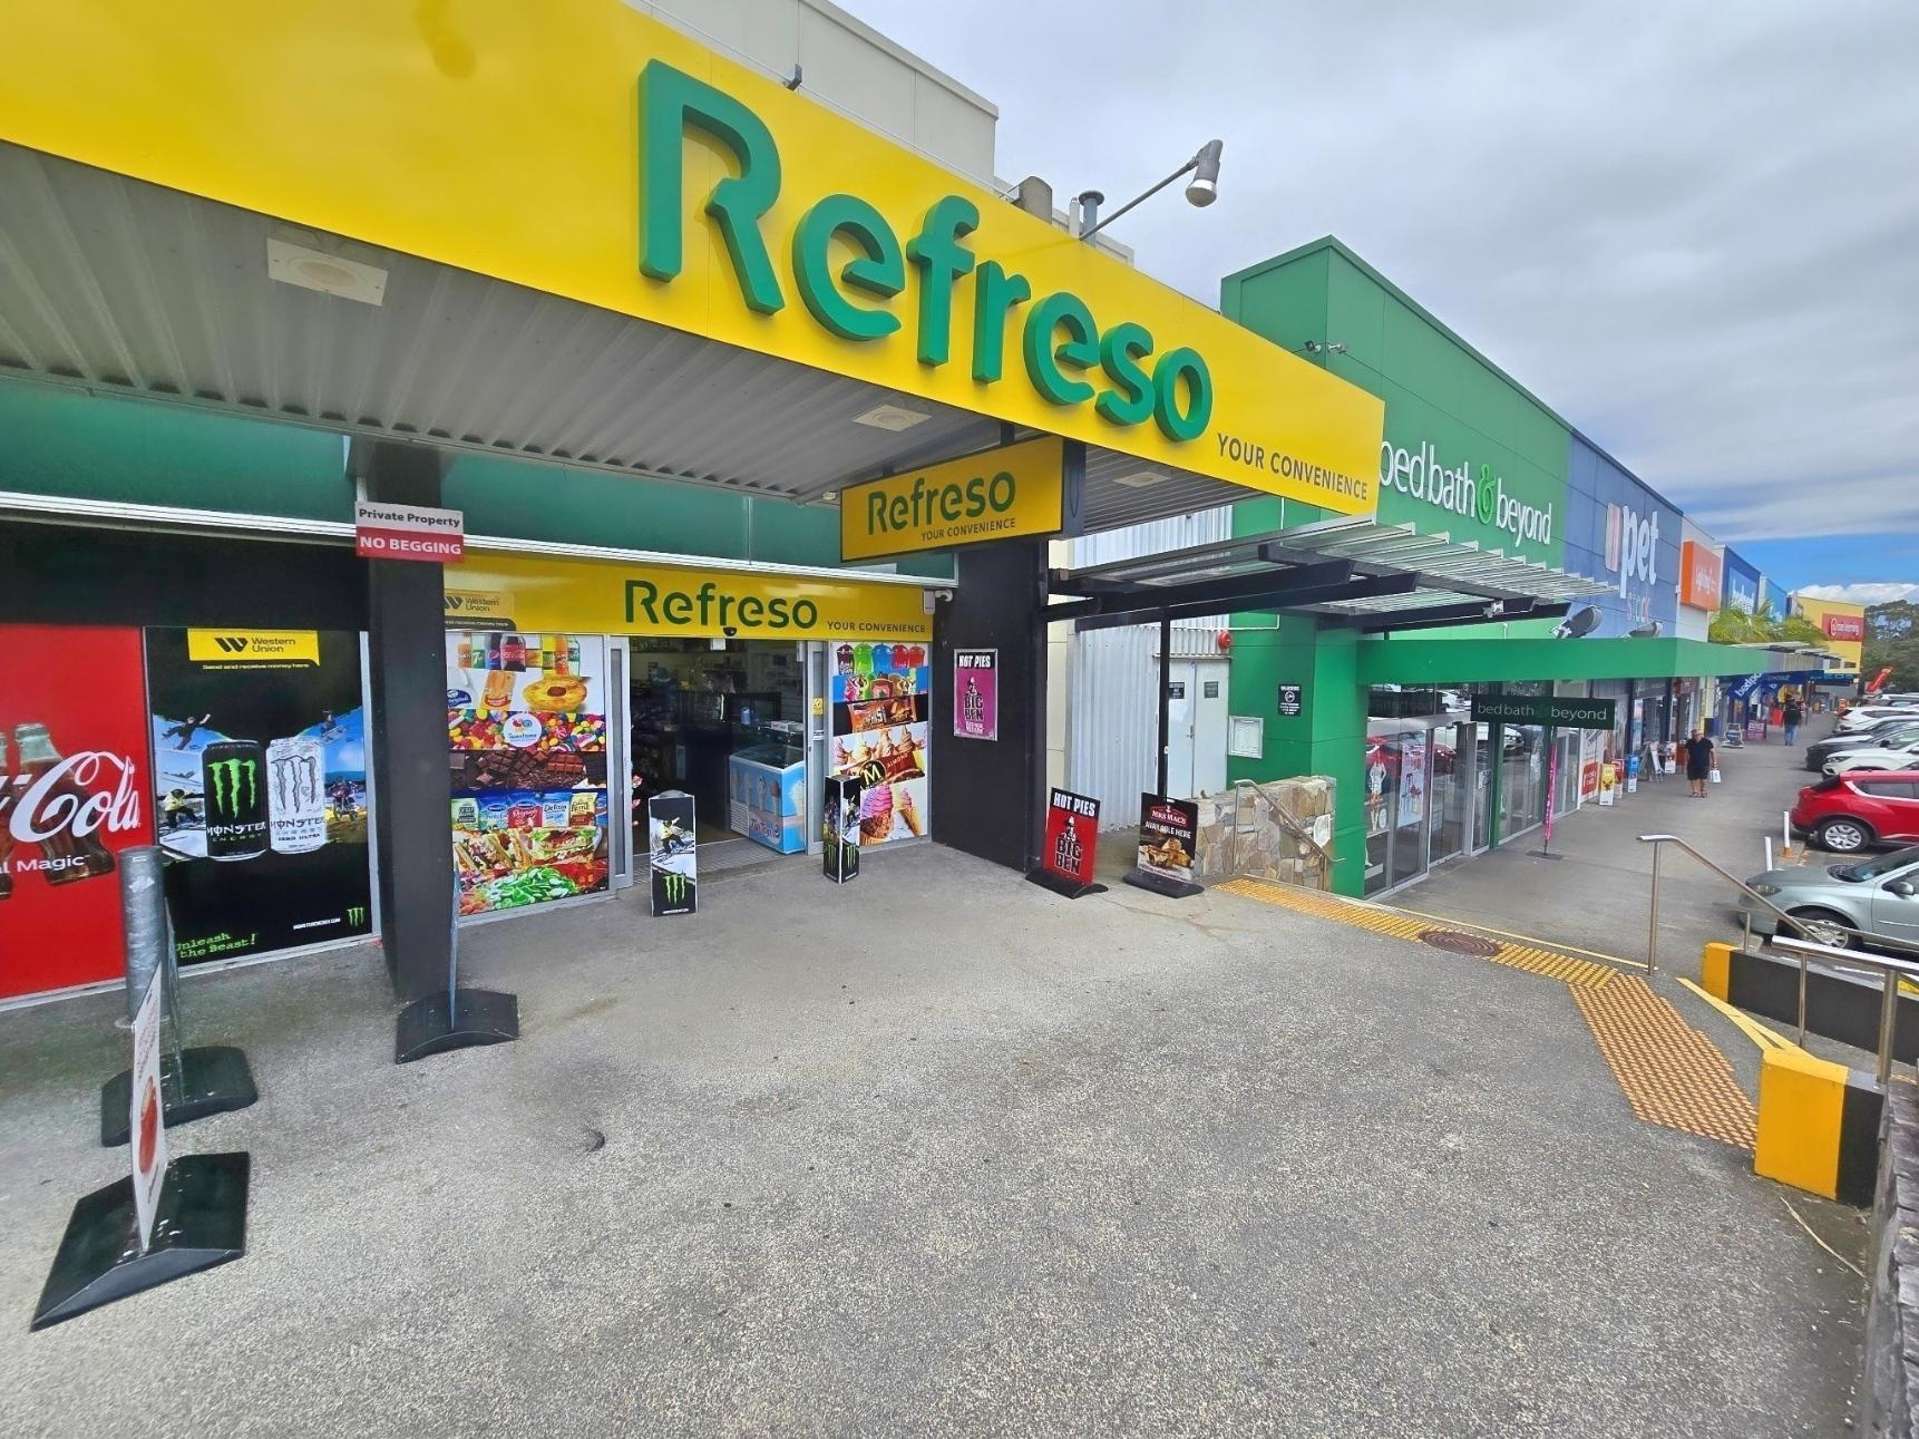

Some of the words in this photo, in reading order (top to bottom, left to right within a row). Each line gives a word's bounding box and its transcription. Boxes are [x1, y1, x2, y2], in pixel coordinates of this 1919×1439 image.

[638, 58, 1213, 442] Refreso
[1217, 432, 1265, 469] YOUR
[1270, 452, 1368, 500] CONVENIENCE
[867, 471, 1016, 536] Refreso
[1428, 444, 1476, 518] bath
[1495, 477, 1552, 548] beyond
[359, 508, 405, 521] Private
[407, 513, 461, 528] Property
[921, 525, 945, 542] YOUR
[947, 517, 1016, 537] CONVENIENCE
[360, 536, 386, 549] NO
[389, 538, 462, 555] BEGGING
[1619, 505, 1659, 600] pet
[625, 580, 818, 629] Refreso
[827, 620, 856, 632] YOUR
[858, 622, 926, 633] CONVENIENCE
[251, 637, 296, 646] Western
[251, 644, 285, 653] Union
[959, 654, 974, 668] HOT
[974, 654, 991, 668] PIES
[1477, 703, 1502, 715] bed
[1504, 703, 1535, 717] bath
[1551, 707, 1608, 721] beyond
[1053, 792, 1073, 810] HOT
[1073, 797, 1096, 817] PIES
[1056, 837, 1083, 860] BIG
[16, 855, 86, 873] Magic
[1054, 852, 1081, 876] BEN
[179, 945, 206, 959] the
